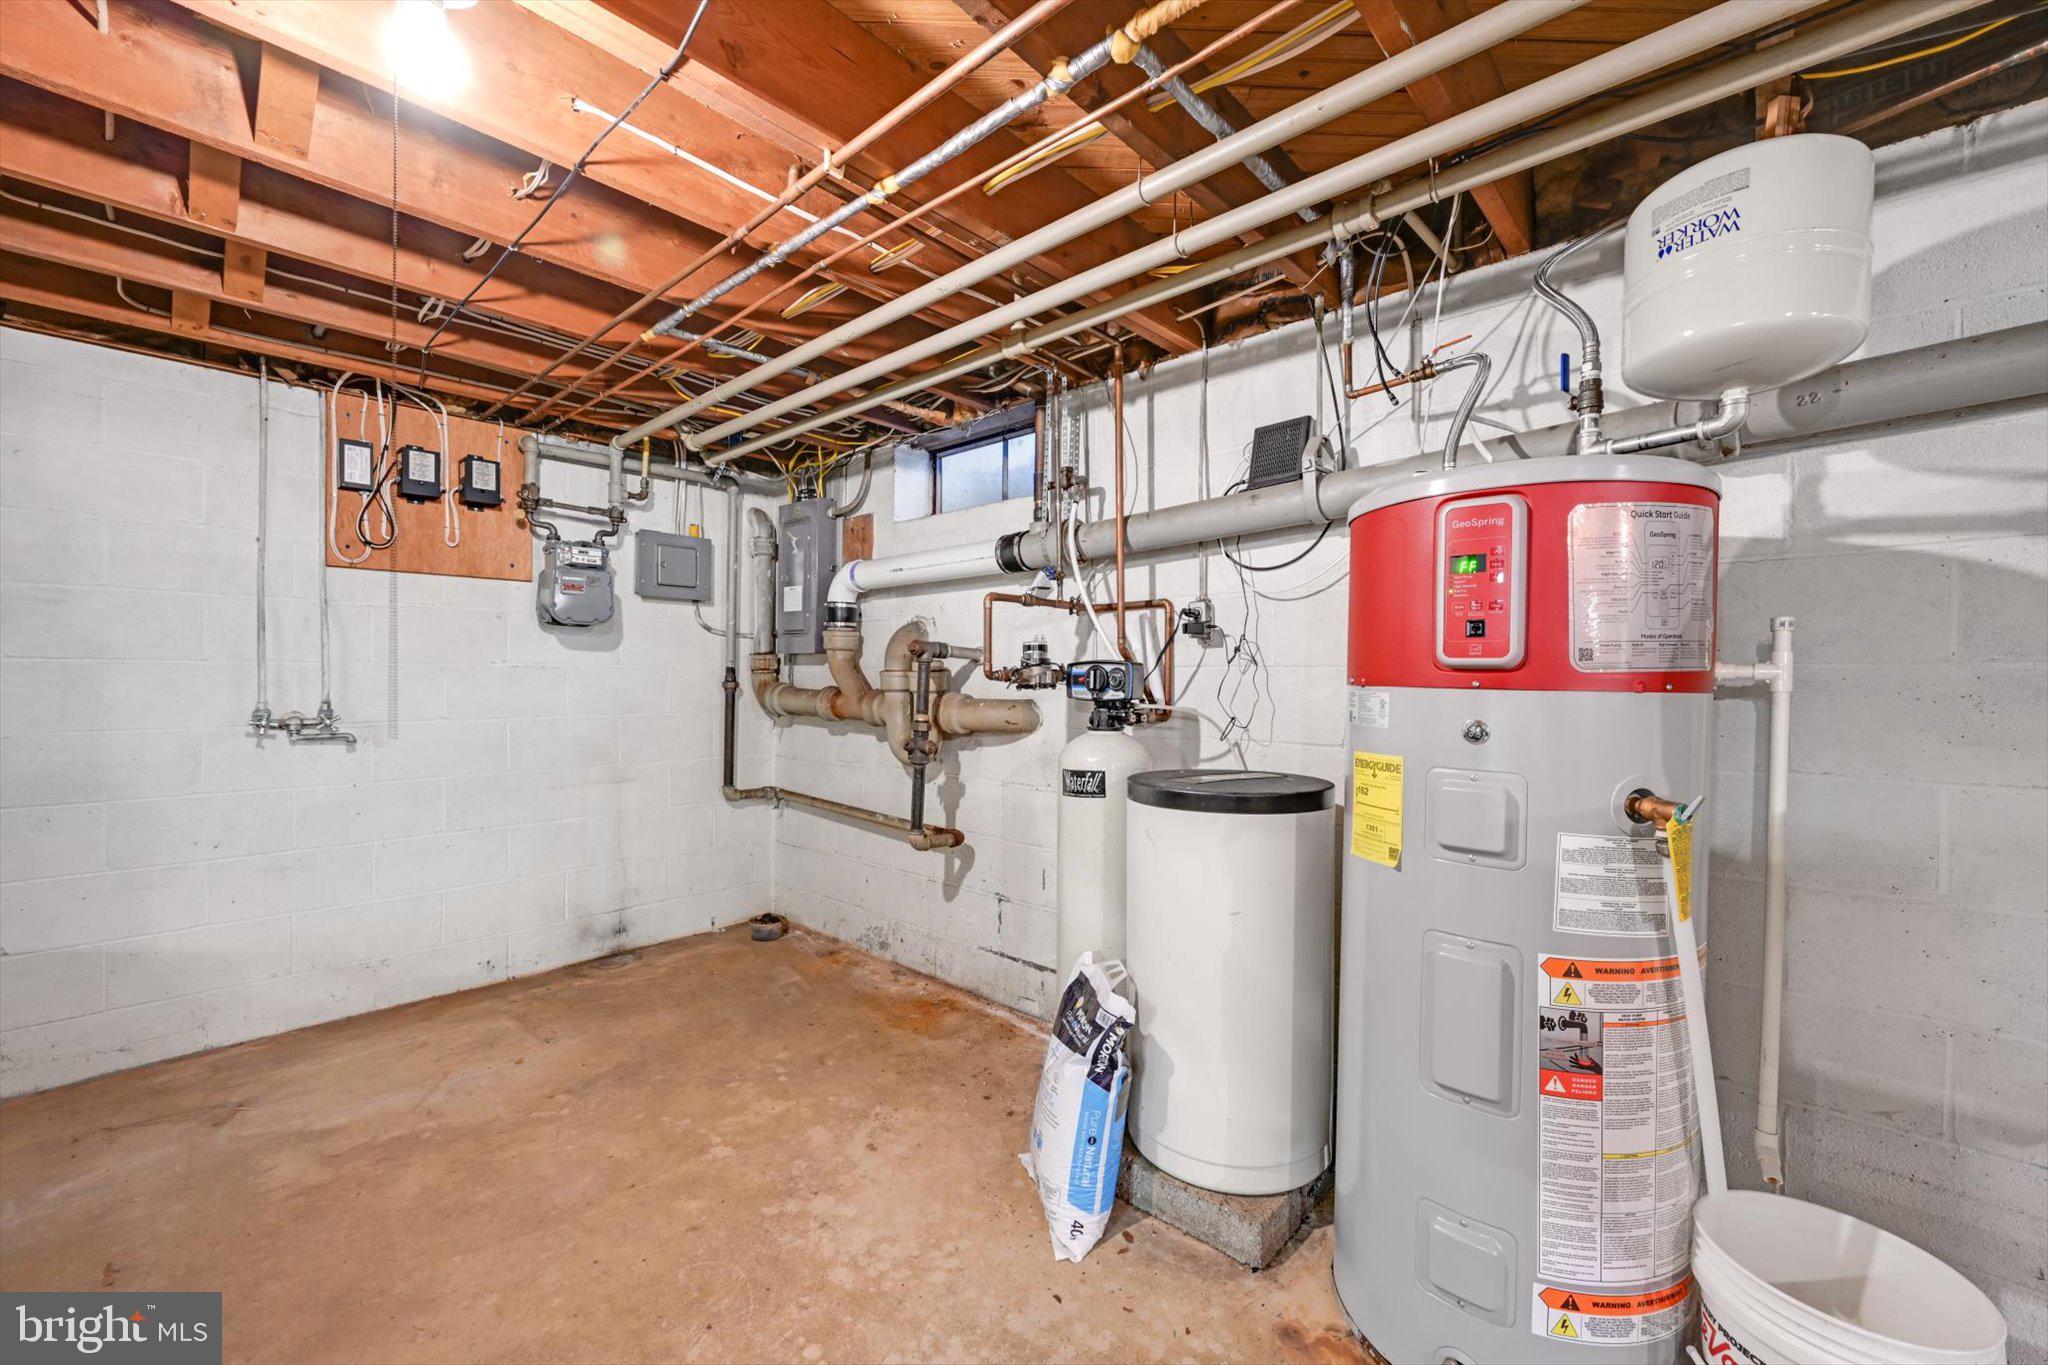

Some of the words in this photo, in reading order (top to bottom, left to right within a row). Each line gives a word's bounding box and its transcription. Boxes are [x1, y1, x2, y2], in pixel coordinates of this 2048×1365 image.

[1657, 207, 1740, 249] WORKER
[1675, 220, 1740, 252] WATER
[1630, 510, 1654, 519] Quick
[1654, 510, 1673, 519] Start
[1673, 511, 1691, 520] Guide
[1451, 516, 1505, 529] GeoSpring
[1649, 531, 1677, 539] GeoSpring
[1063, 770, 1103, 793] Waterfall
[1595, 967, 1635, 975] WARNING
[1592, 1301, 1631, 1309] WARNING
